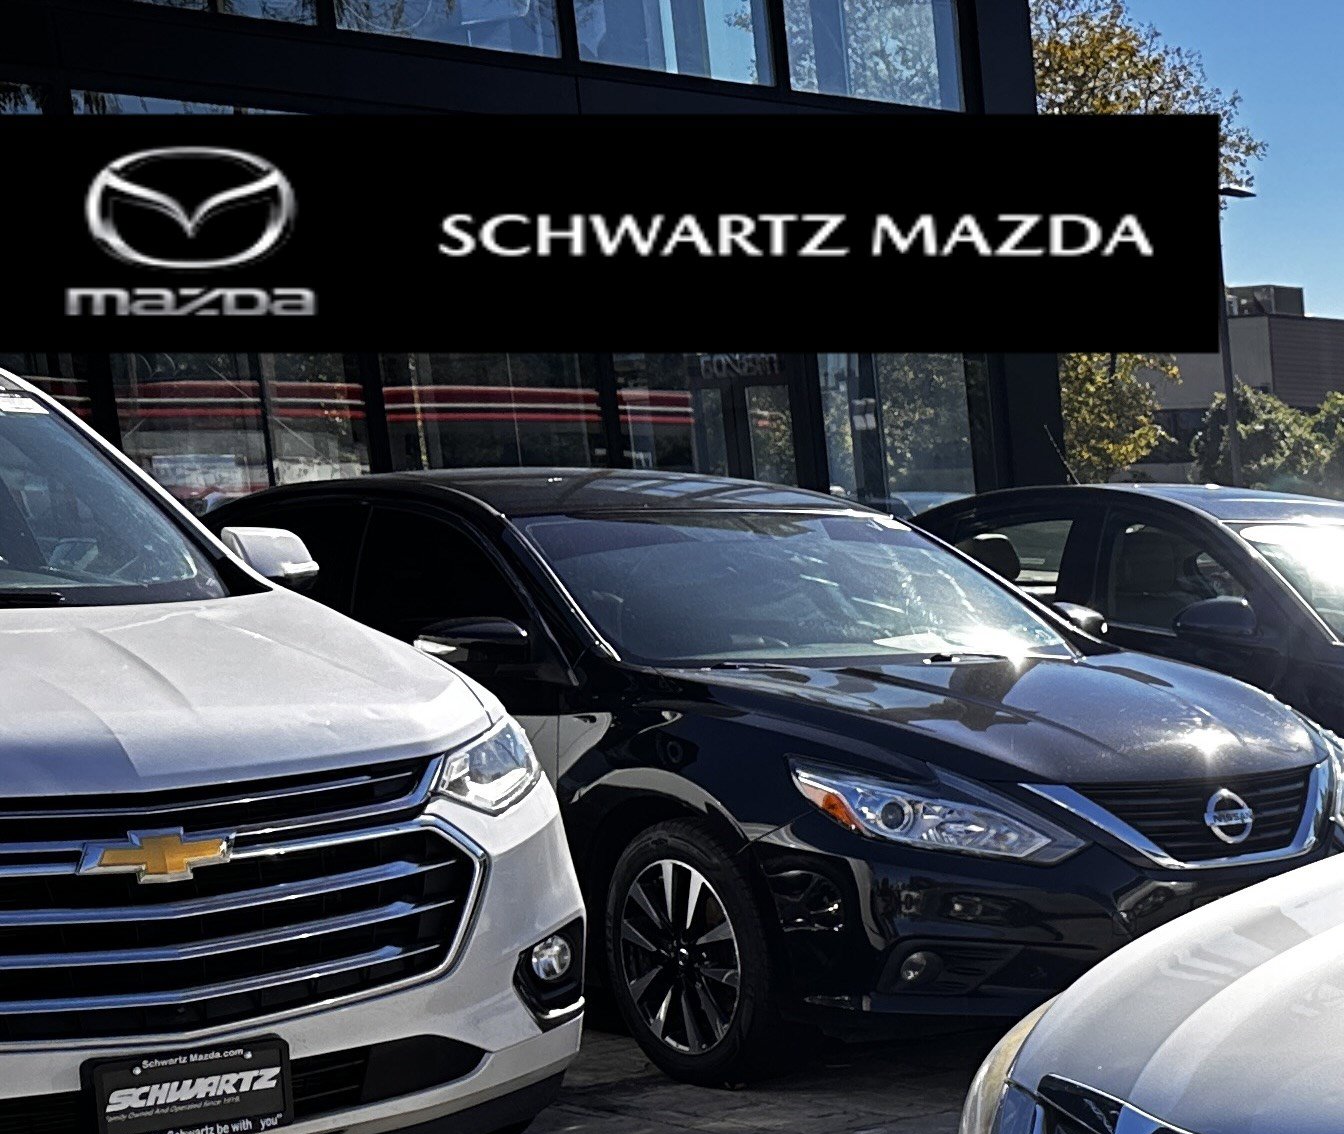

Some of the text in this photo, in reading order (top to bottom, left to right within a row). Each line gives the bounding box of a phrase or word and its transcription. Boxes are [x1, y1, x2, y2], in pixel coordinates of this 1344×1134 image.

[141, 1053, 188, 1069] Schwartz
[105, 1066, 281, 1113] SCHWARTZ
[216, 1121, 230, 1134] be
[230, 1119, 253, 1132] with
[260, 1113, 283, 1131] you"
